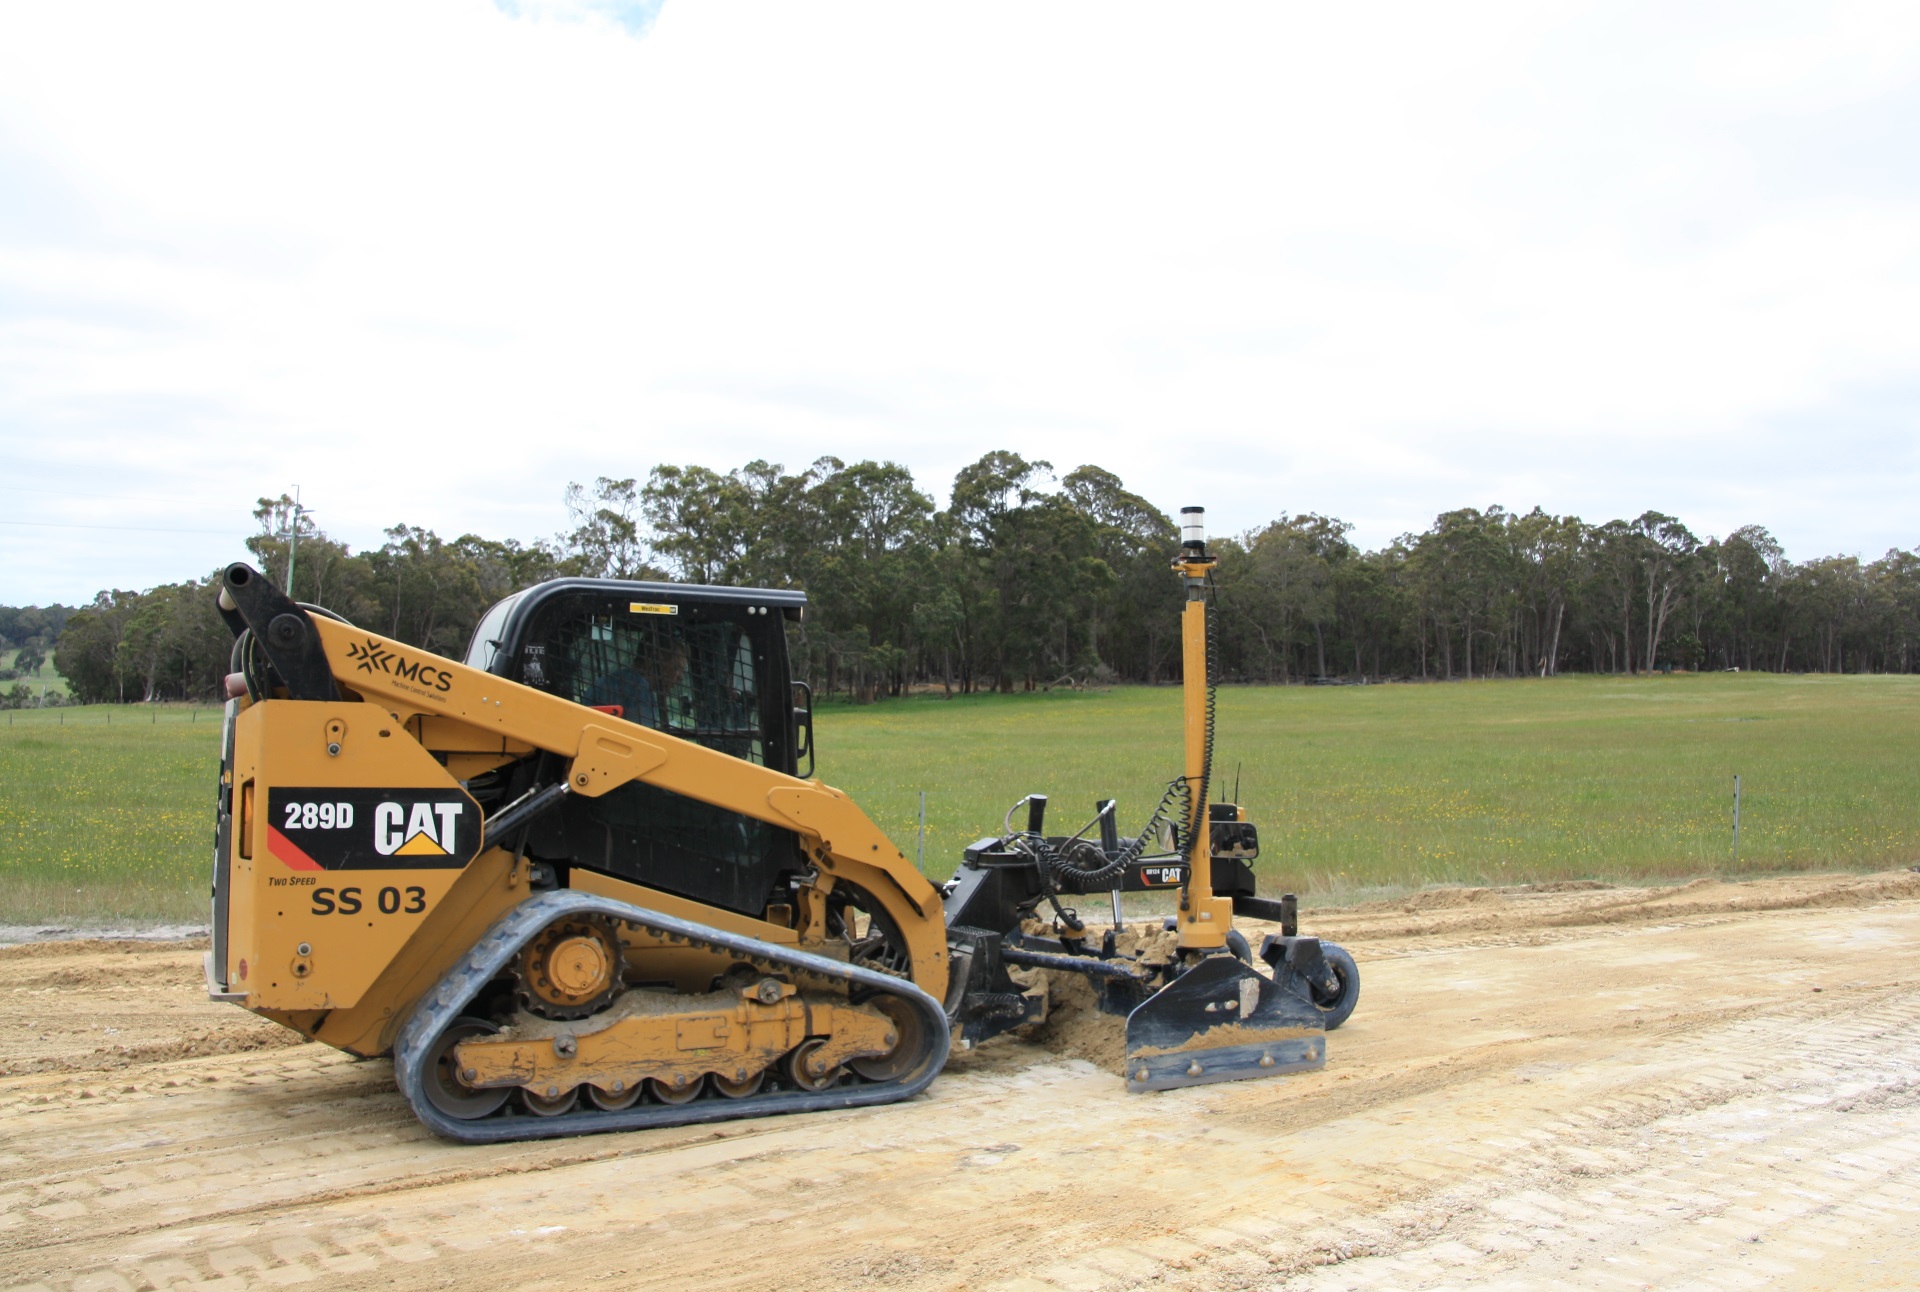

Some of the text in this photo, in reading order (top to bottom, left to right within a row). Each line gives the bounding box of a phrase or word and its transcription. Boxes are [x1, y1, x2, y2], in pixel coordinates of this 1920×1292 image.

[395, 657, 453, 692] MCS
[284, 802, 354, 830] 289D
[374, 801, 463, 856] CAT
[268, 876, 317, 887] TWO SPEED
[1161, 868, 1182, 883] CAT
[311, 886, 427, 916] SS 03
